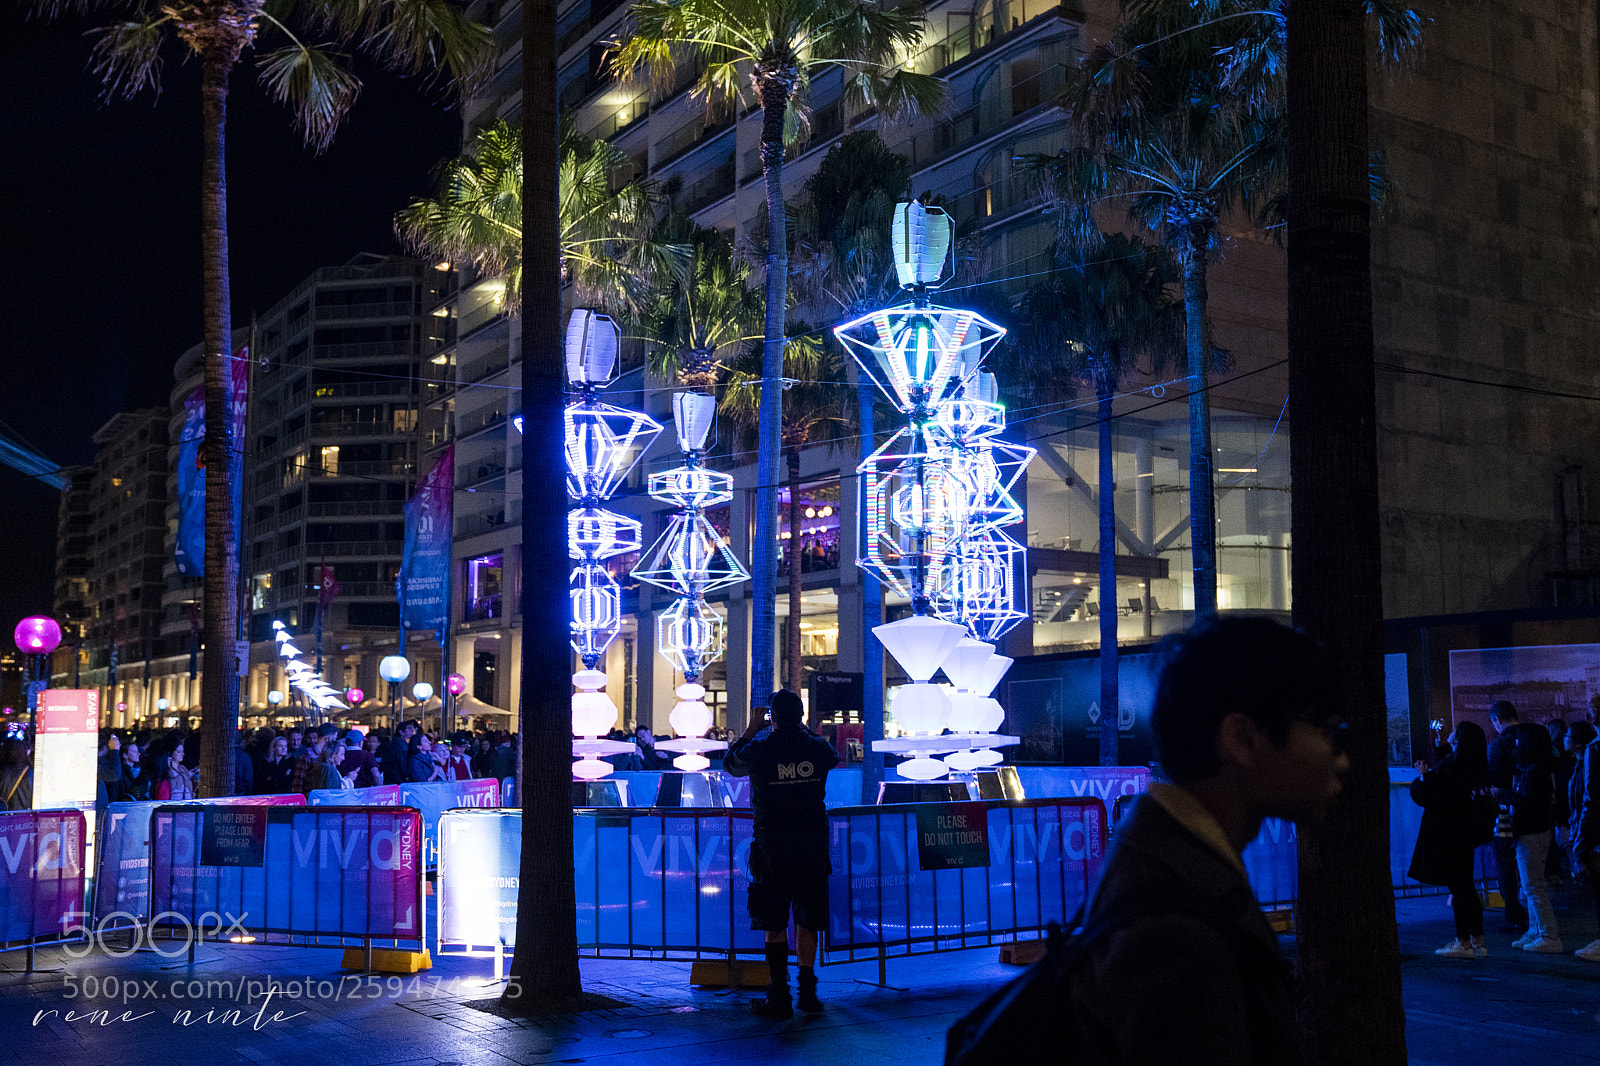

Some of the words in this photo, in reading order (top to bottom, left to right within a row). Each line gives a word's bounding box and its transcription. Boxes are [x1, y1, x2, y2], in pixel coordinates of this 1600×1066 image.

[826, 675, 852, 684] Telephone
[777, 761, 814, 780] MO
[213, 813, 221, 824] DO
[222, 813, 235, 824] NOT
[937, 814, 968, 830] PLEASE
[214, 825, 237, 836] PLEASE
[237, 826, 253, 836] LOOK
[924, 832, 936, 847] DO
[937, 831, 955, 846] NOT
[955, 830, 983, 845] TOUCH
[1090, 808, 1101, 859] SYDNEY
[216, 838, 234, 848] FROM
[234, 838, 250, 848] AFAR
[401, 818, 412, 871] SYDNEY
